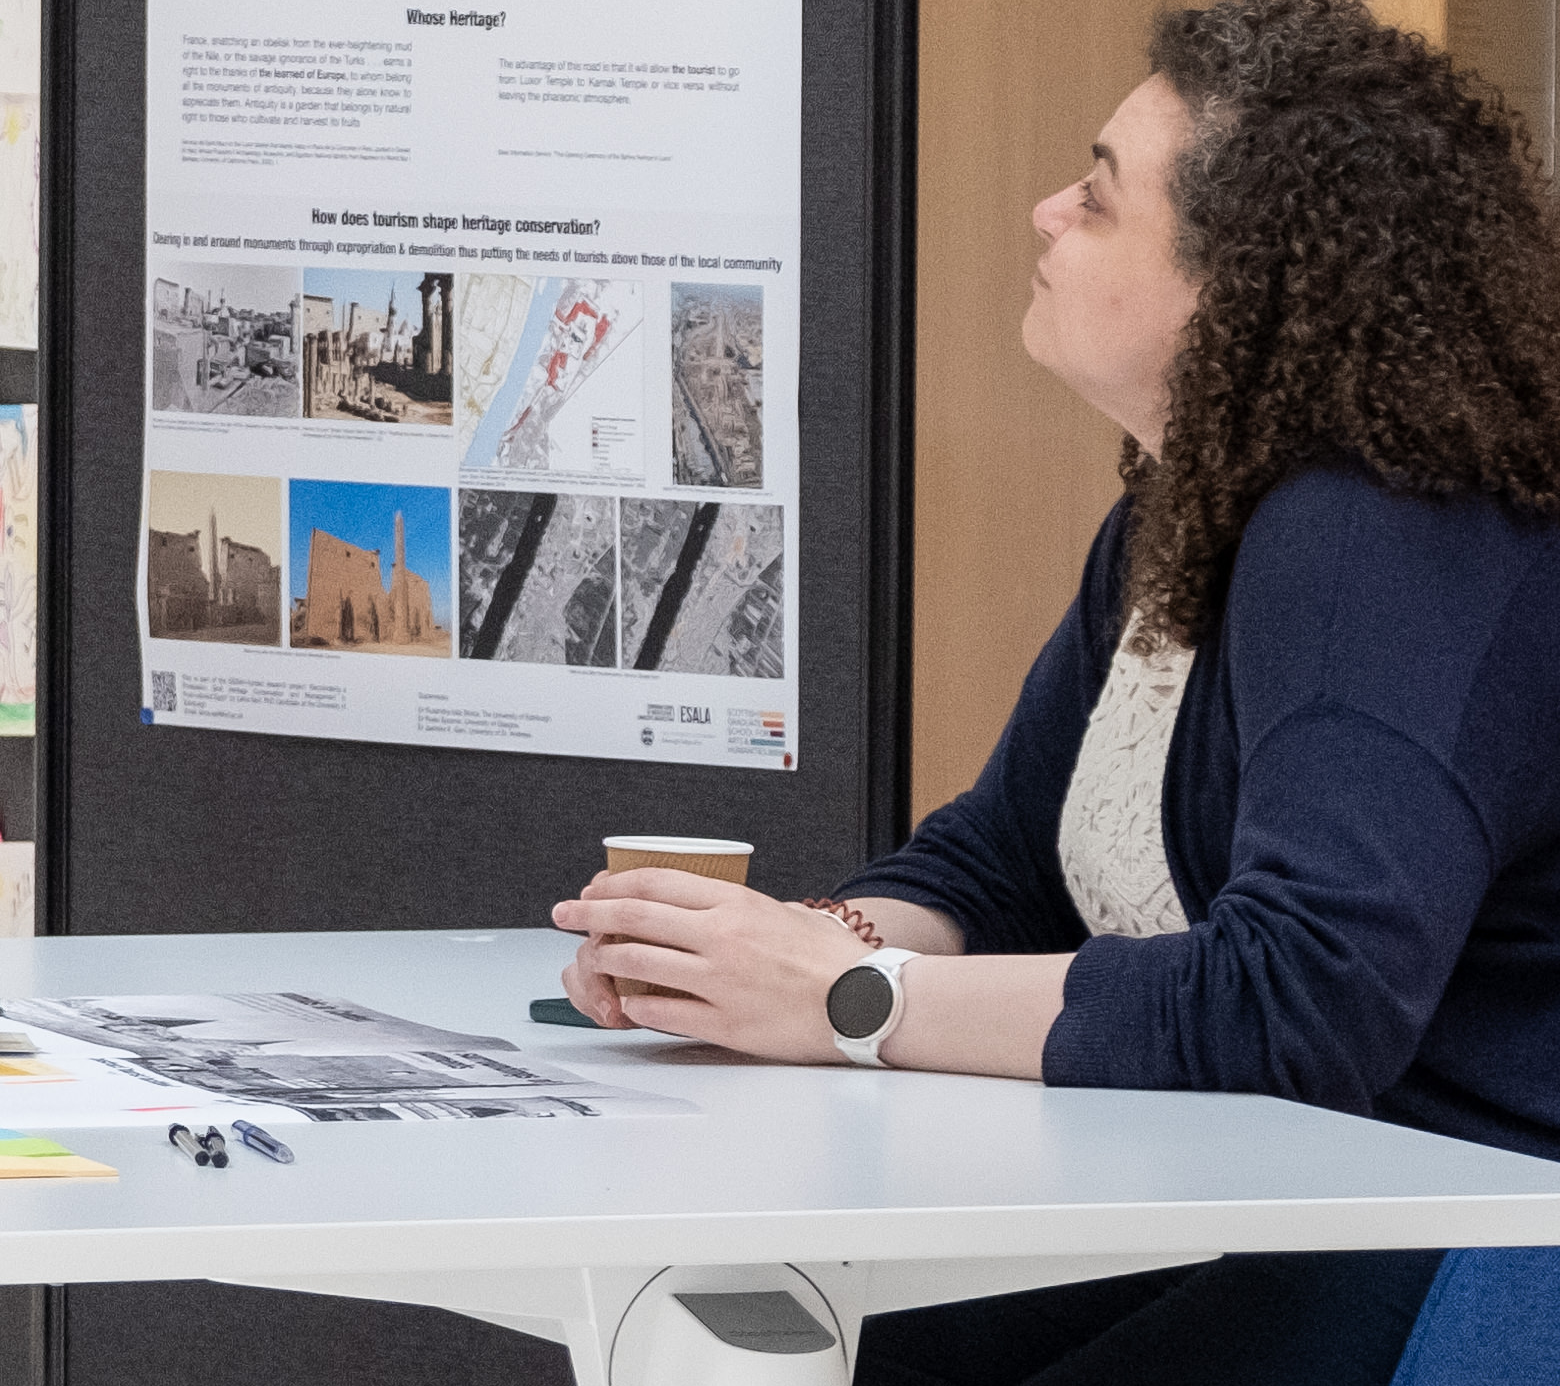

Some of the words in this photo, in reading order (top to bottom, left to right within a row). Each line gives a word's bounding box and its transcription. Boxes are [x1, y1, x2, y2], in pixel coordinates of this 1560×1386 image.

[406, 8, 446, 26] Whose
[449, 9, 507, 31] Heritage?
[311, 208, 338, 225] How
[341, 209, 370, 226] does
[372, 211, 418, 229] tourism
[422, 212, 458, 233] shape
[461, 215, 512, 235] heritage
[515, 218, 601, 236] conservation?
[193, 233, 209, 247] and
[210, 235, 241, 249] around
[243, 237, 297, 251] monuments
[298, 238, 334, 255] through
[336, 240, 397, 256] expropriation
[516, 247, 531, 260] the
[533, 248, 560, 262] needs
[641, 253, 666, 267] those
[680, 254, 695, 268] the
[698, 255, 721, 269] local
[723, 258, 783, 274] community
[679, 705, 711, 725] ESALA
